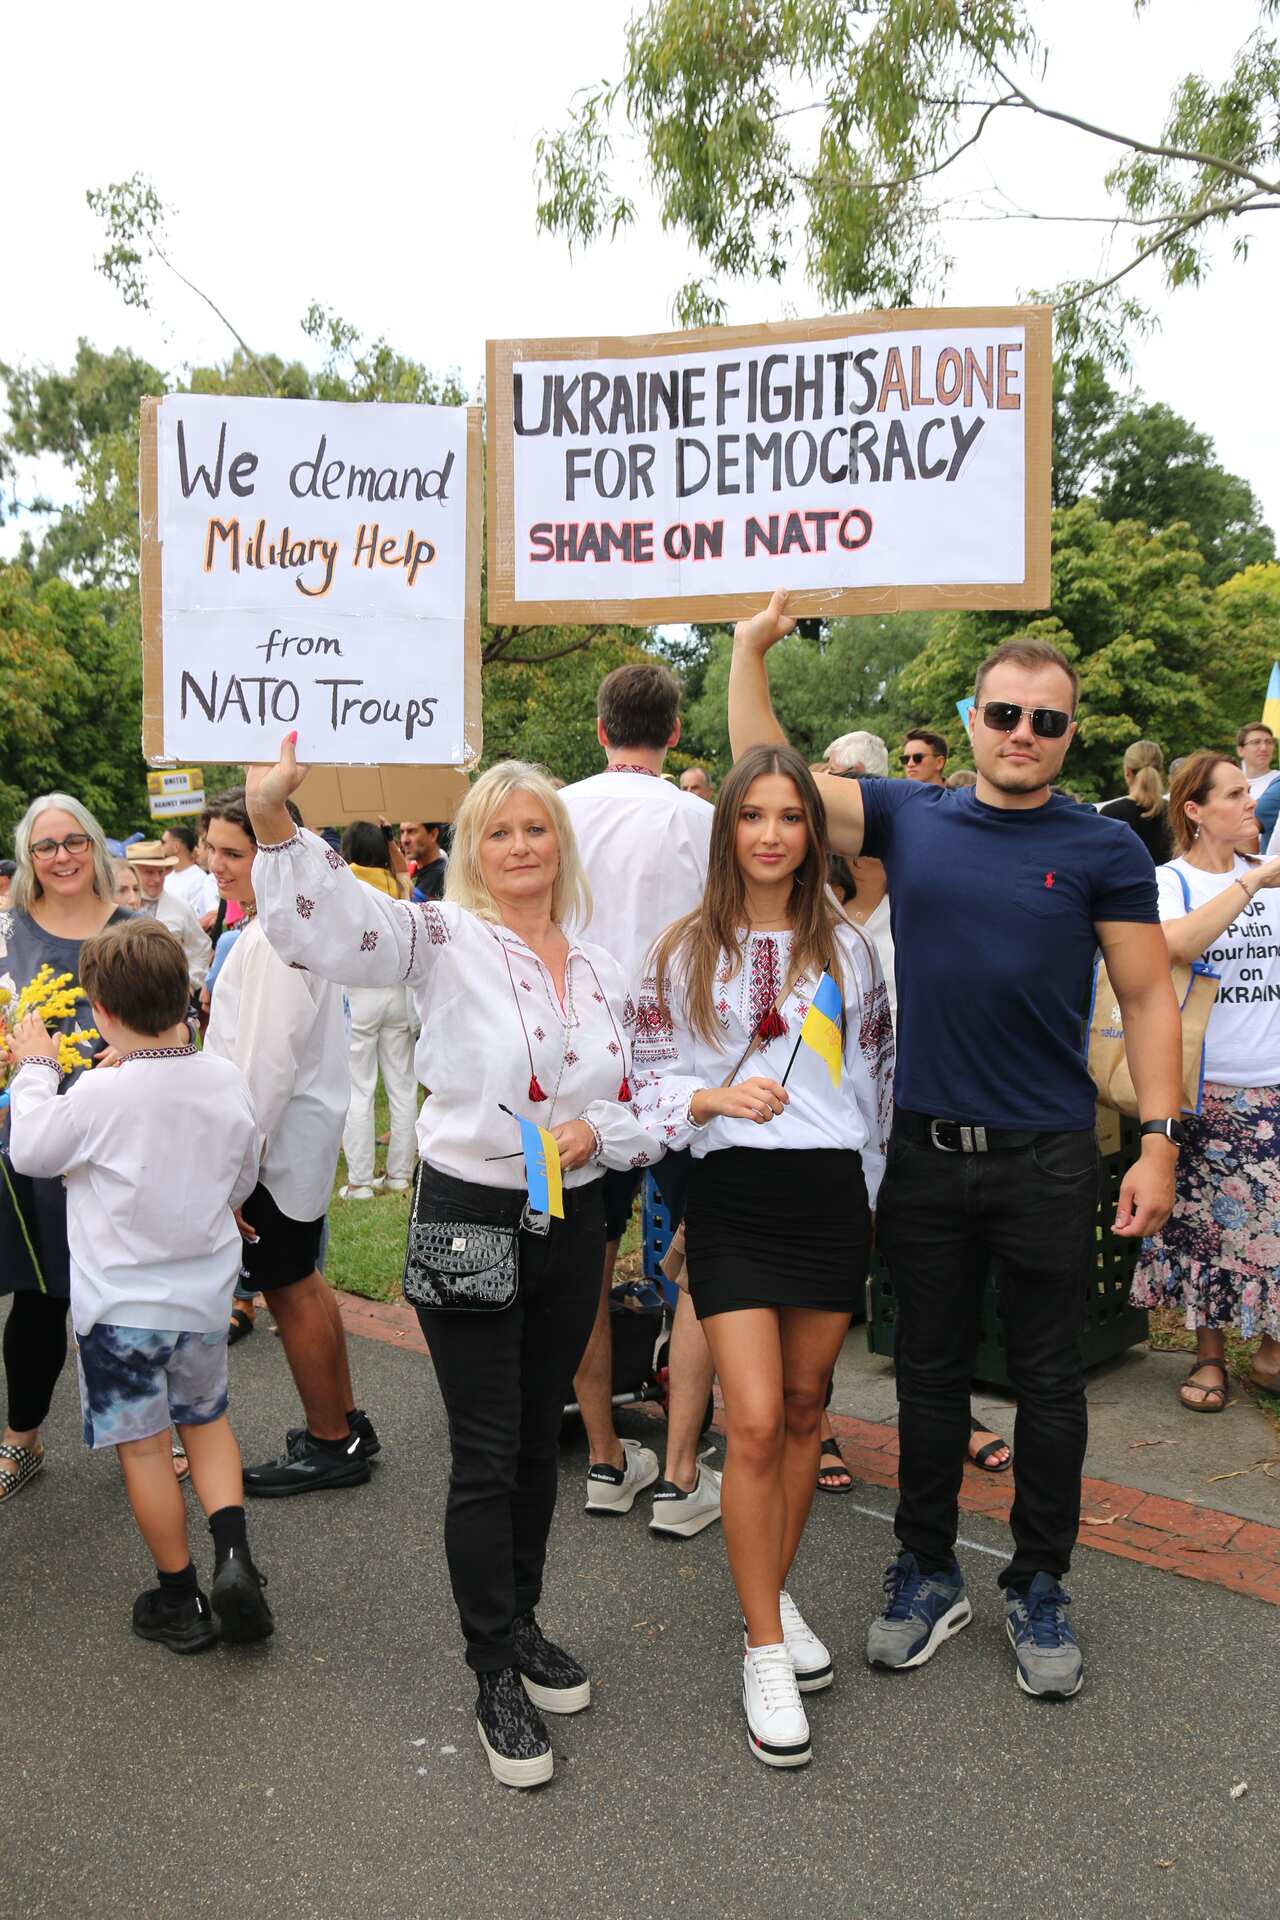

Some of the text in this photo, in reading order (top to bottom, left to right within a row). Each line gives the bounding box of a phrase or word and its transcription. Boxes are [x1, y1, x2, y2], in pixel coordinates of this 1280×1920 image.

[513, 343, 1022, 437] UKRAINE FIGHTS ALONE
[177, 420, 455, 507] We demand
[565, 416, 985, 501] FOR DEMOCRACY
[529, 508, 873, 562] SHAME ON NATO
[204, 518, 436, 597] Military Help
[256, 629, 345, 664] from
[180, 670, 440, 740] NATO Troups
[1227, 922, 1272, 938] Putin
[1243, 901, 1265, 917] OP
[1201, 942, 1280, 964] your han
[1239, 968, 1263, 981] on
[1213, 984, 1280, 1004] KRAIN
